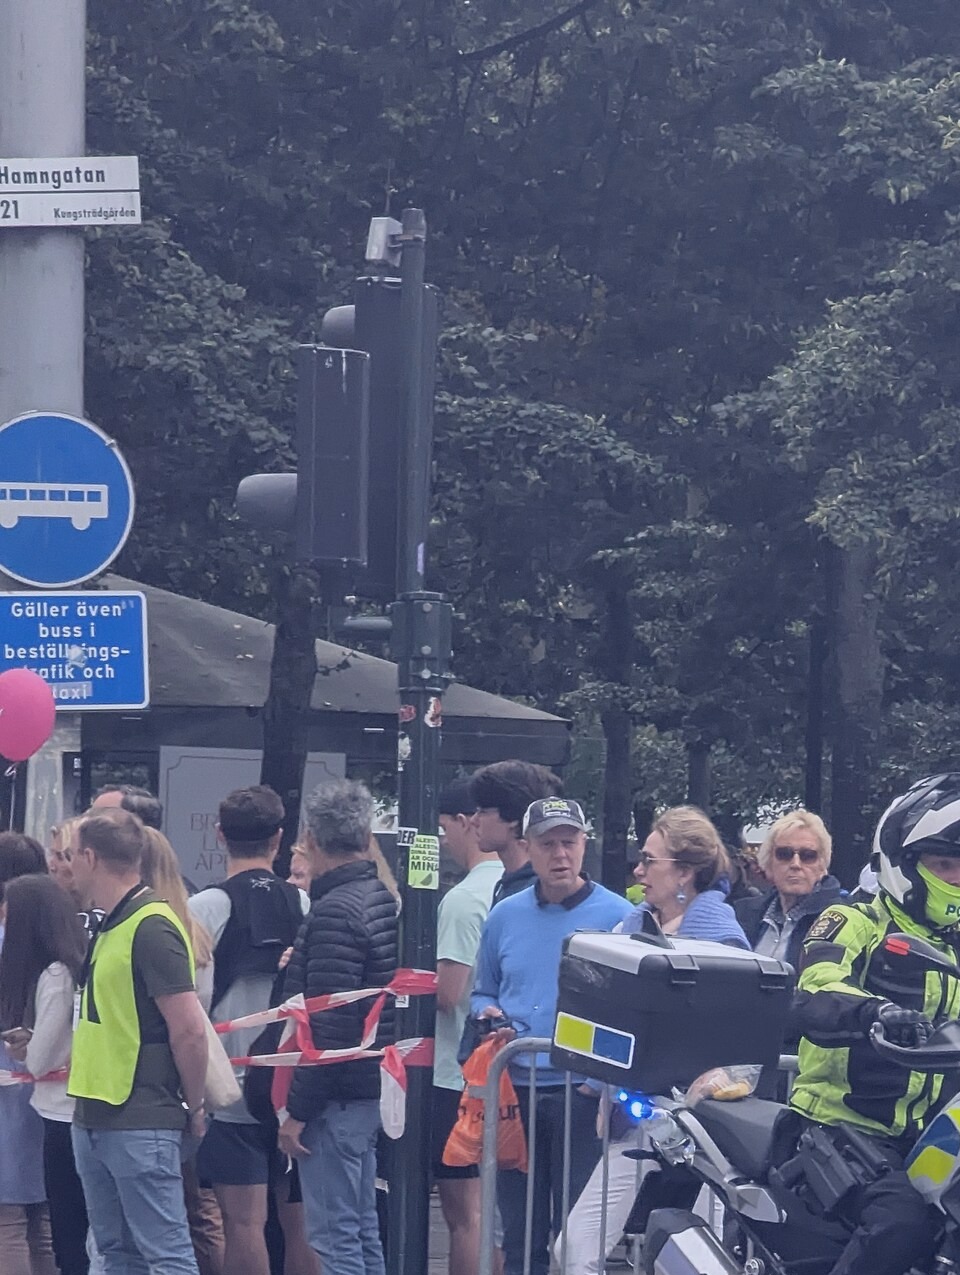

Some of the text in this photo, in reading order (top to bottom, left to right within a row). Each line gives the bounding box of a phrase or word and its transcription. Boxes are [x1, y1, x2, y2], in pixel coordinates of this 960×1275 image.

[0, 166, 105, 189] Hamngatan
[11, 602, 122, 617] Gäller även
[39, 622, 96, 638] buss i
[5, 643, 131, 662] beställings-
[24, 664, 115, 679] afik och
